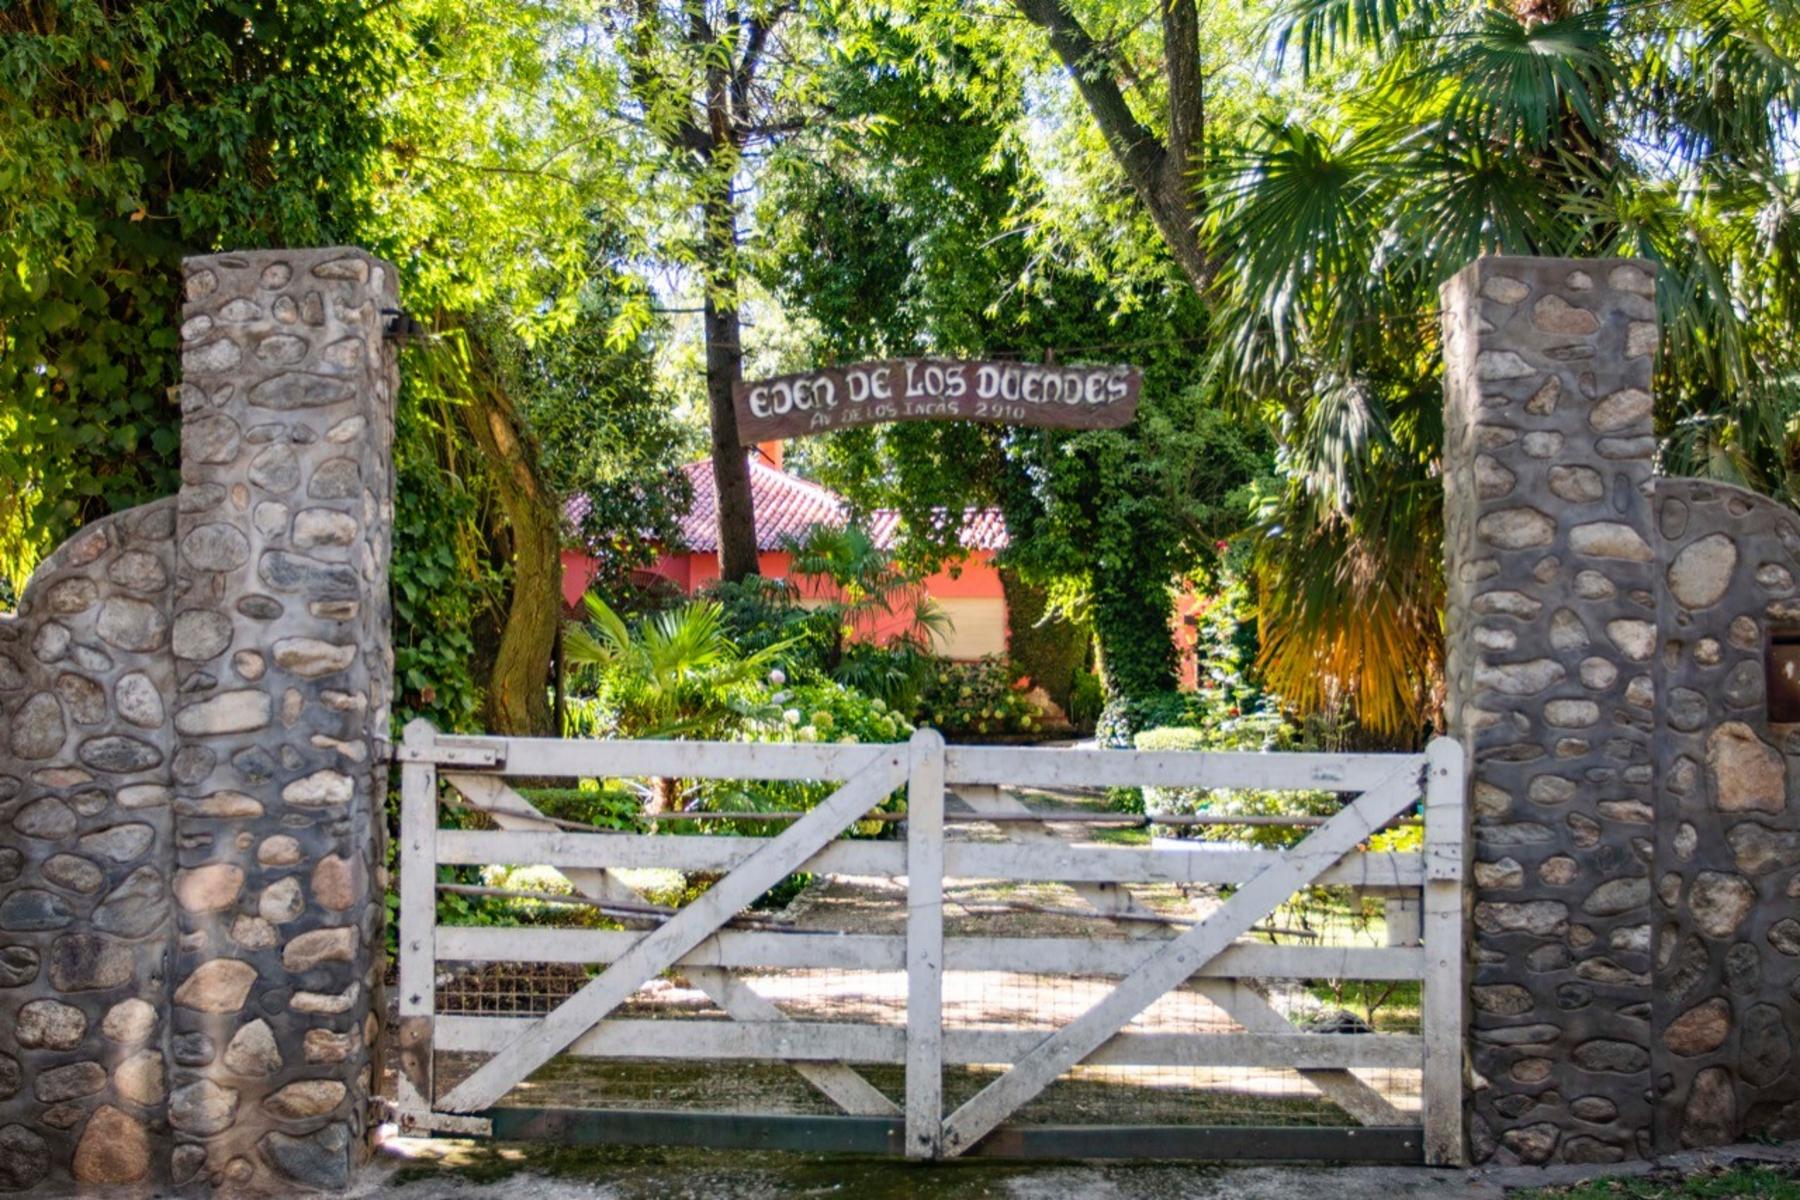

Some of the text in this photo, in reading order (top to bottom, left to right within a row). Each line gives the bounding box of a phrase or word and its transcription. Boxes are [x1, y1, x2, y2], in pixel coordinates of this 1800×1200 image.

[845, 366, 893, 402] DE
[905, 361, 967, 398] LOS
[976, 365, 1128, 405] DUENDES
[841, 408, 859, 422] DE
[867, 404, 898, 419] LOS
[903, 399, 959, 416] INCAS
[975, 402, 1025, 419] 2910
